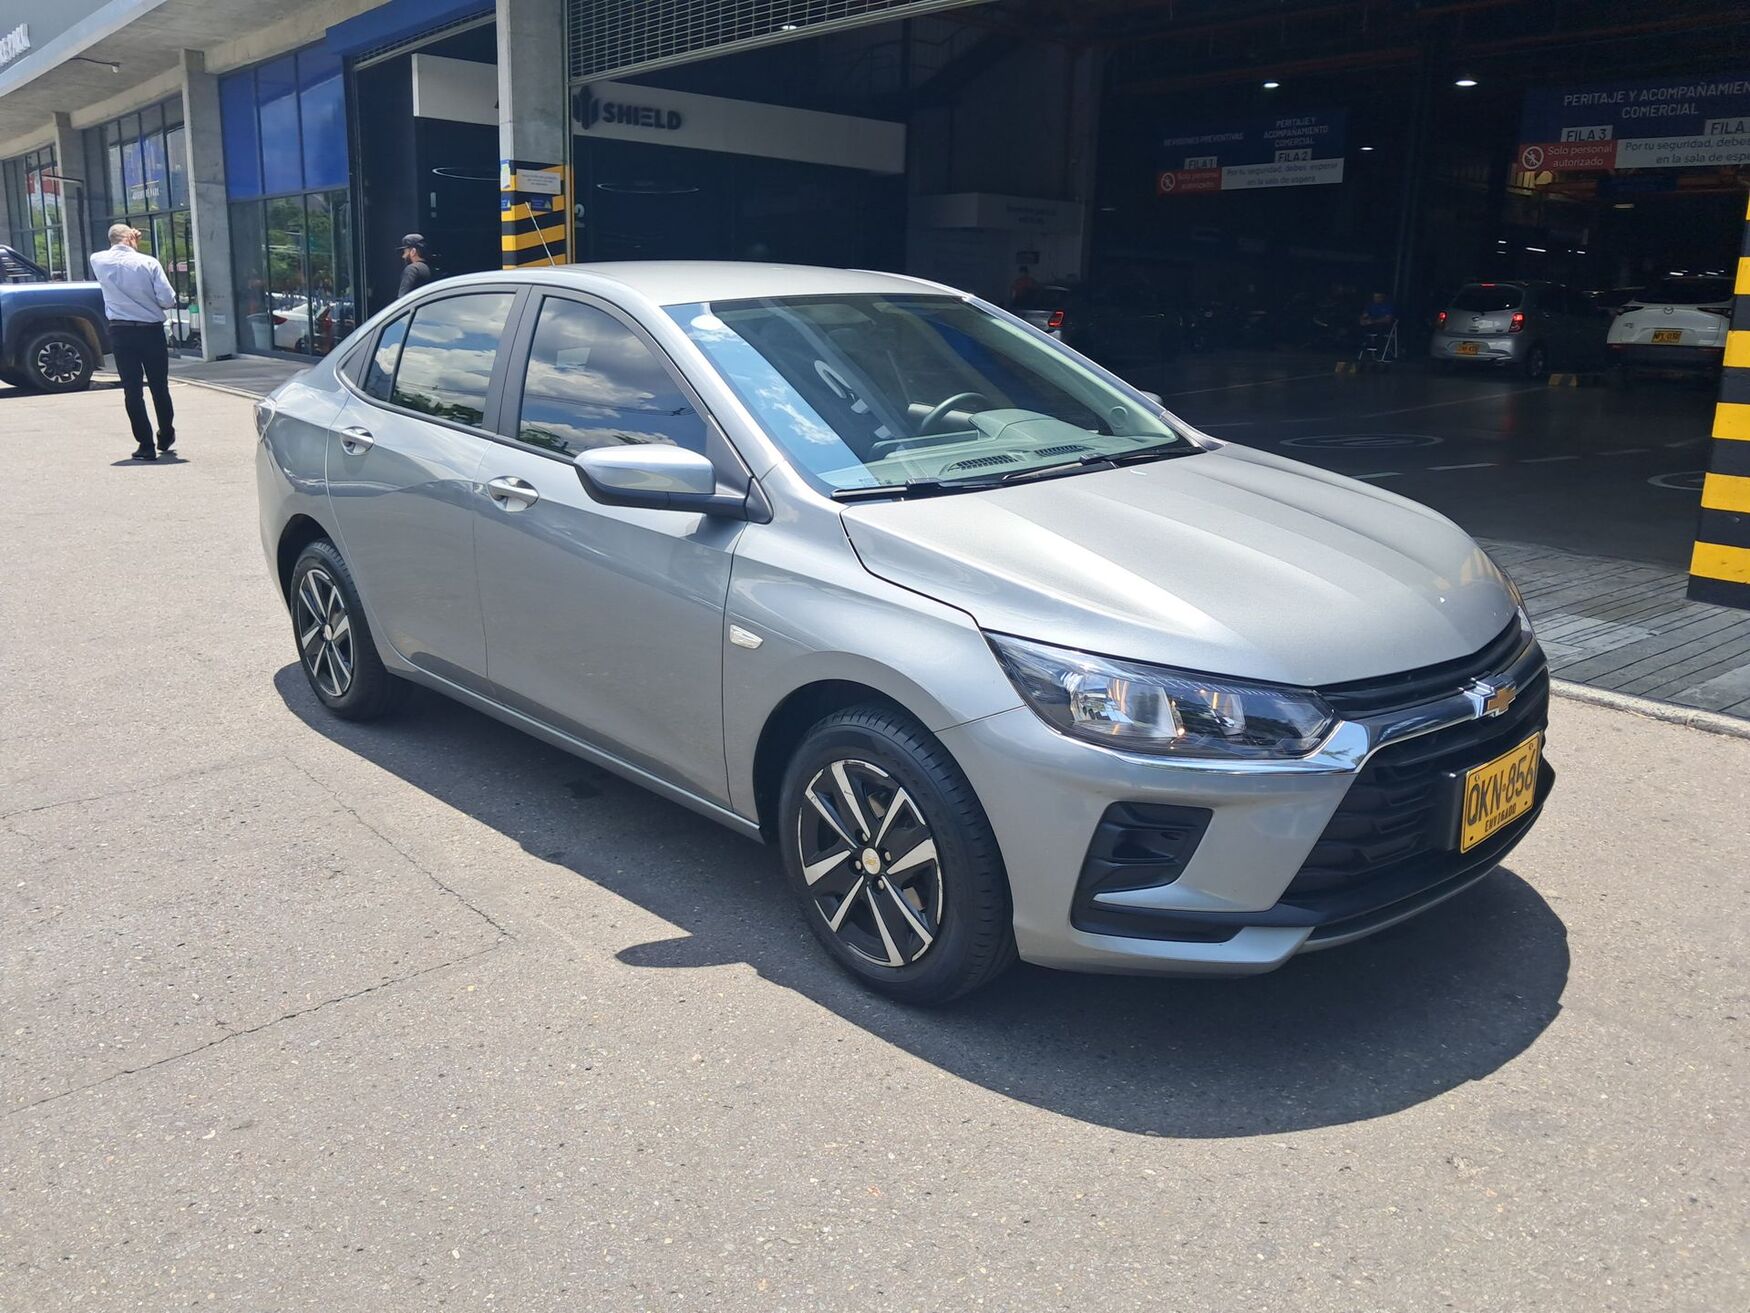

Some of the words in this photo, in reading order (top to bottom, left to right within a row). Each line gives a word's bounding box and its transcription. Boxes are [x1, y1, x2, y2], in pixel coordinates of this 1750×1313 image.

[1563, 91, 1625, 107] PERITAJE
[1628, 90, 1638, 102] Y
[603, 102, 682, 130] SHIELD
[1621, 103, 1699, 119] COMERCIAL
[1566, 130, 1596, 142] FILA
[1598, 128, 1608, 141] 3
[1711, 121, 1745, 135] FILA
[1547, 145, 1569, 156] Solo
[1570, 143, 1613, 158] personal
[1625, 141, 1643, 152] Por
[1644, 141, 1655, 151] tu
[1278, 152, 1299, 162] FILA
[1301, 151, 1308, 161] 2
[1553, 156, 1604, 168] autorizado
[1656, 156, 1670, 165] en
[1672, 153, 1682, 164] la
[1684, 152, 1706, 163] sala
[1708, 151, 1723, 162] de
[1484, 802, 1517, 833] ENVIGADO
